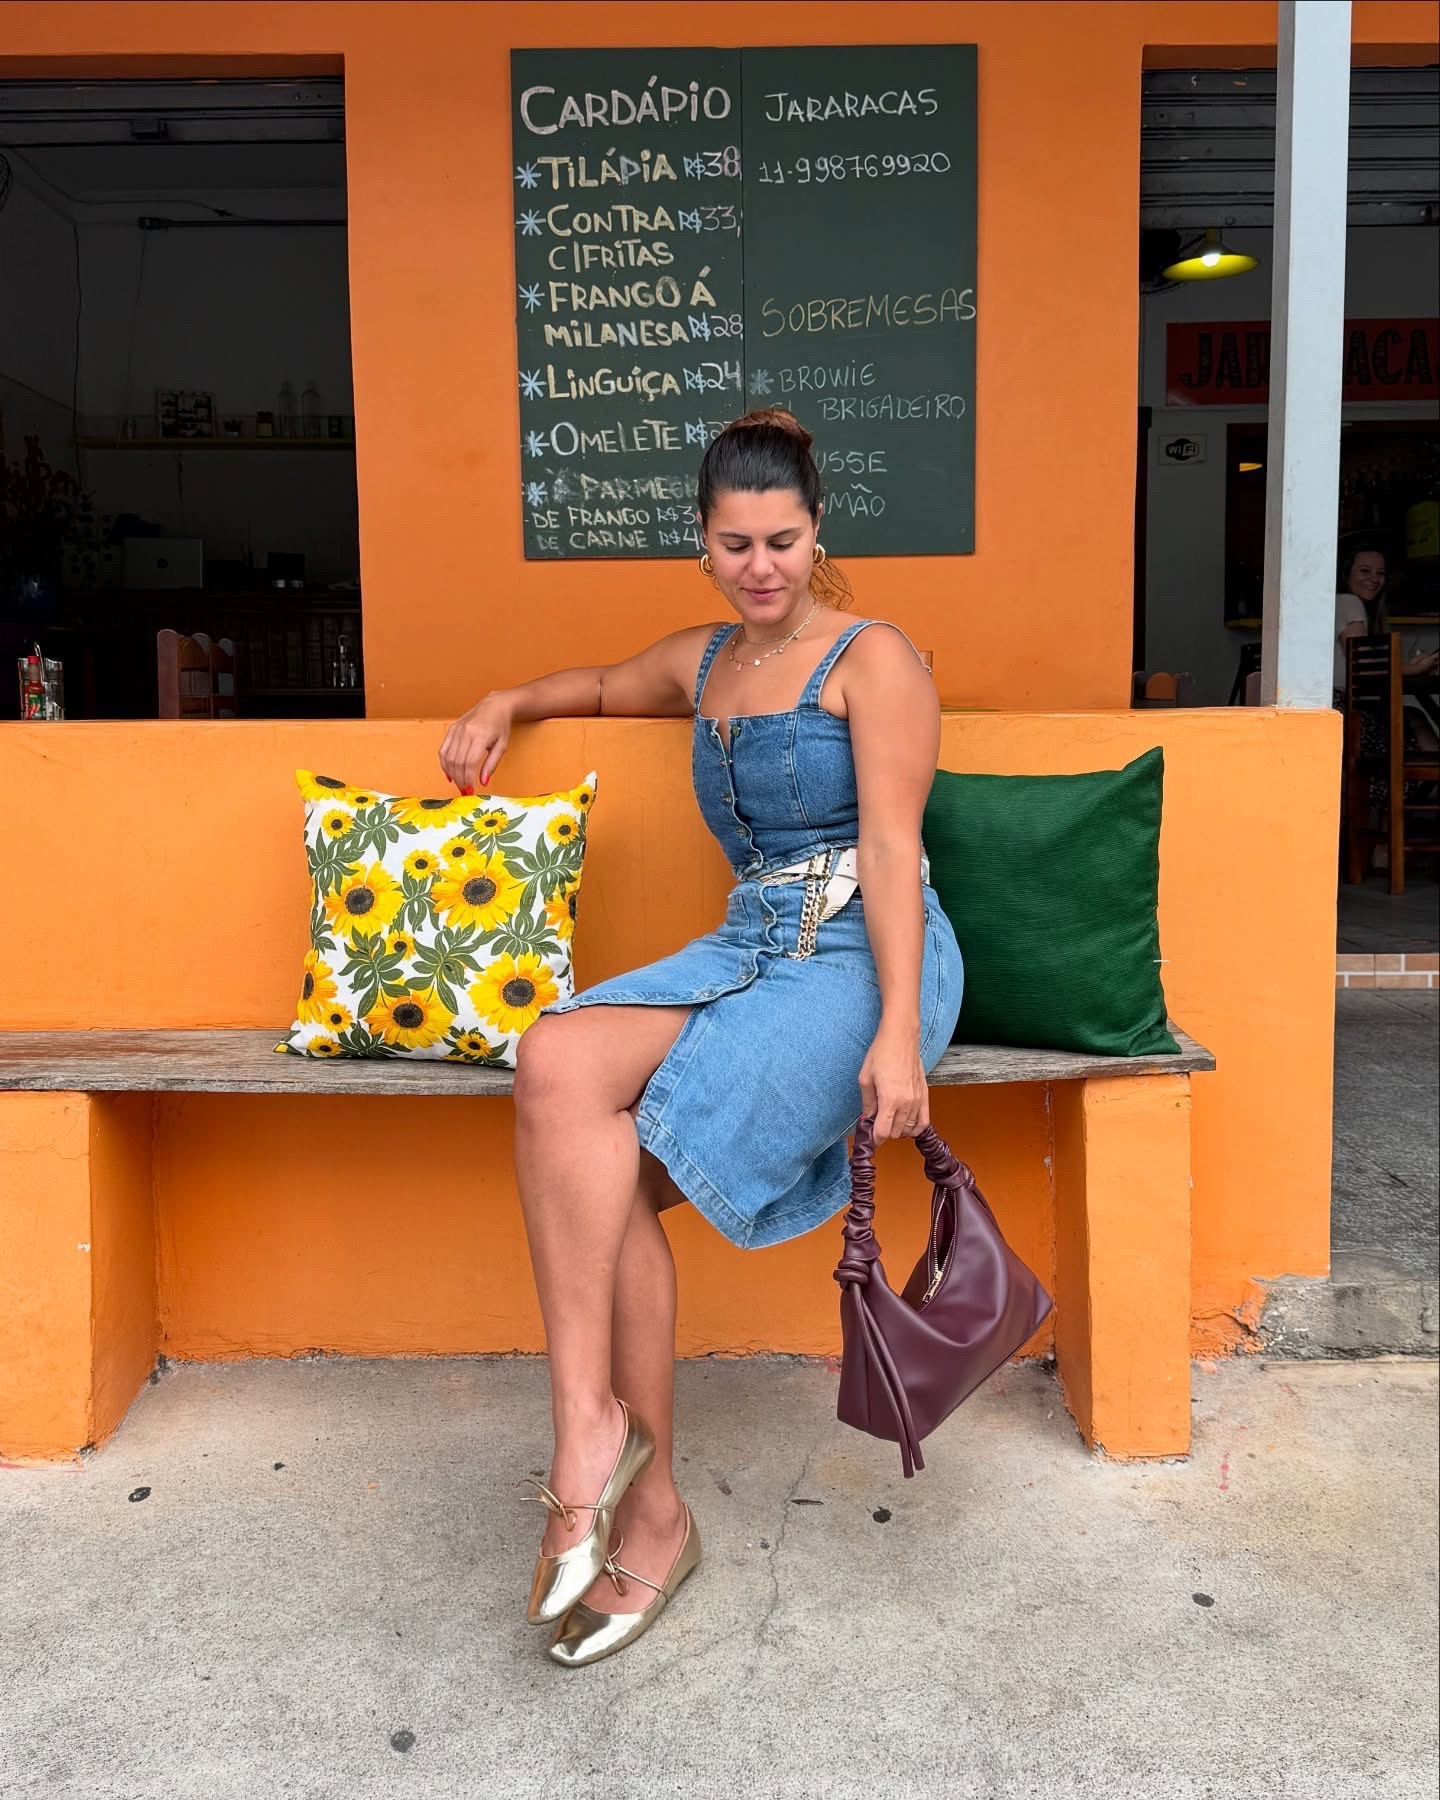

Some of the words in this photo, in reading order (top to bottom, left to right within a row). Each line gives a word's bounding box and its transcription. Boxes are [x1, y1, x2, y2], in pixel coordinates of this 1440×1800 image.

[764, 88, 939, 123] JARARACAS
[759, 152, 951, 184] 11-998769920
[547, 203, 676, 237] CONTRA
[548, 275, 682, 313] FRANGO
[761, 288, 977, 338] SOBREMESAS
[683, 361, 742, 394] R$24
[817, 393, 966, 421] BRIGADEIRO
[551, 418, 682, 456] OMELETE
[684, 417, 733, 449] R$2
[815, 451, 887, 475] USSE
[531, 510, 560, 529] DE
[567, 505, 651, 527] FRANGO
[656, 505, 697, 525] R$3
[823, 483, 886, 518] IMÃO
[536, 534, 560, 550] DE
[569, 529, 649, 550] CARNE
